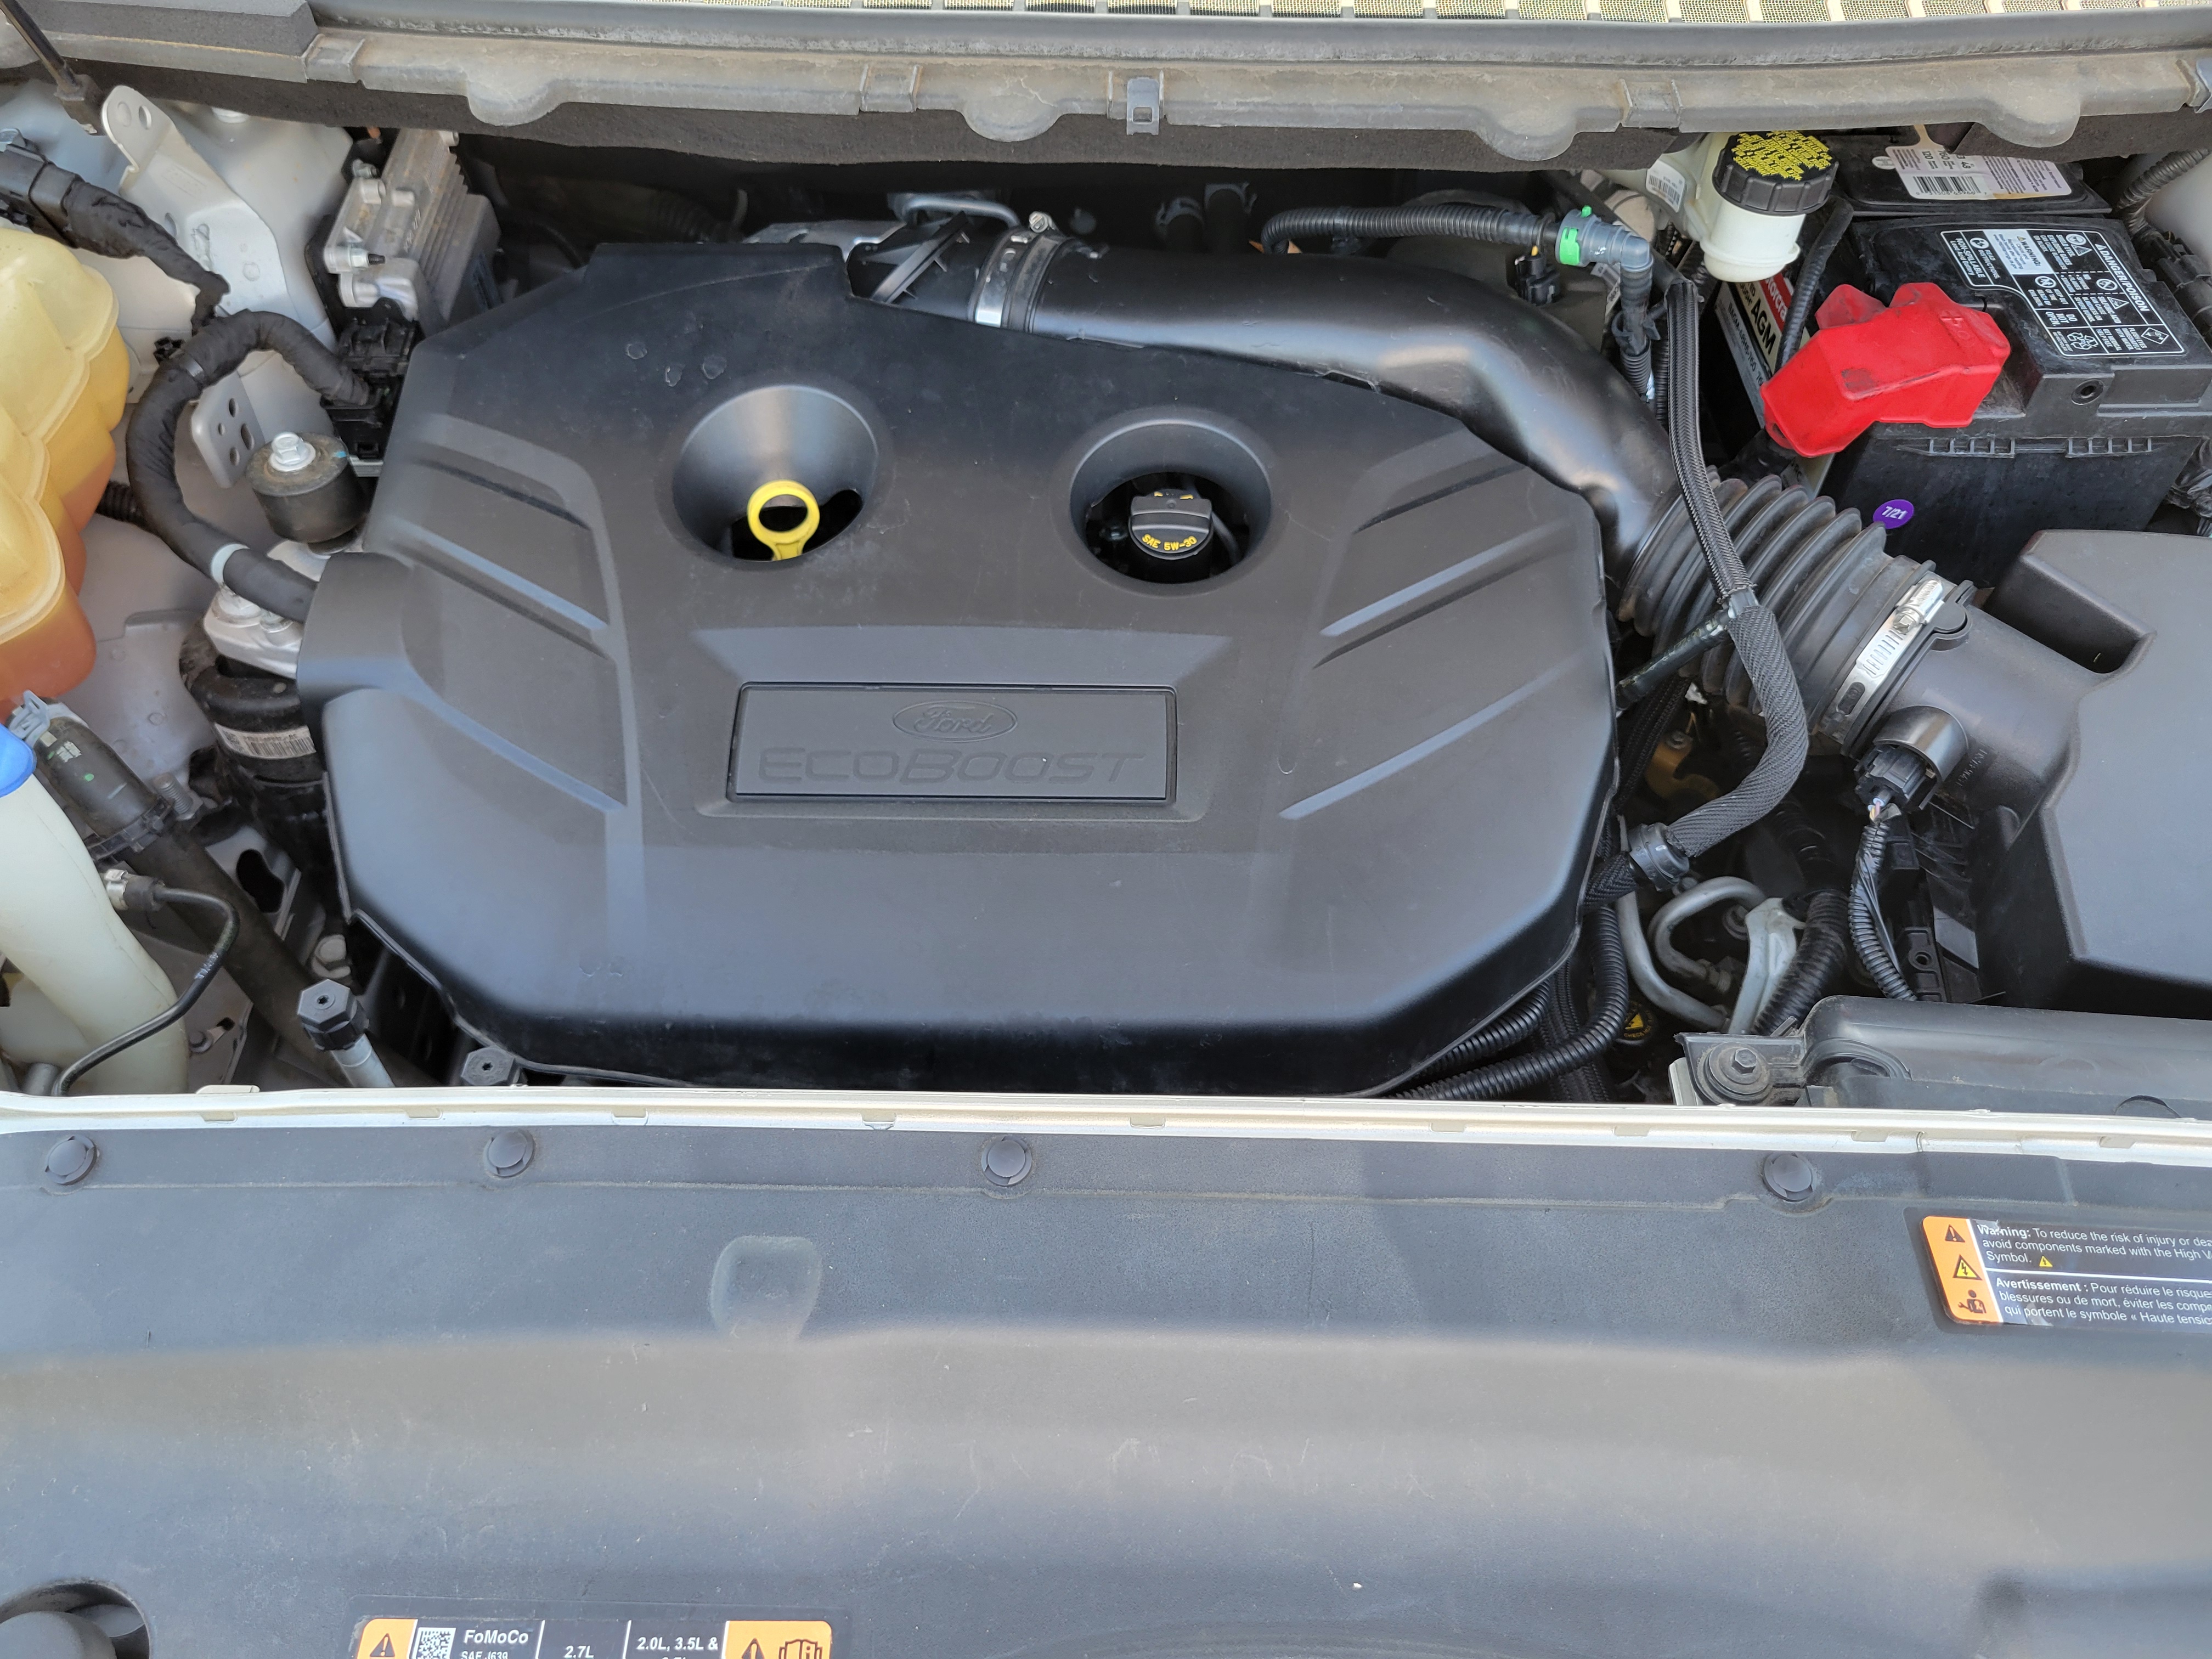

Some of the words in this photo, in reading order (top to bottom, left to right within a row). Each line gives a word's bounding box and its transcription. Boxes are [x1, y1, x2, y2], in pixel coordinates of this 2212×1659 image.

[1922, 151, 1933, 160] 120
[1949, 240, 1961, 250] Lead
[1954, 238, 1987, 278] NON-SPILLABLE
[1955, 251, 1967, 260] Acid
[1984, 250, 1996, 260] READ
[2019, 241, 2042, 266] WARNING:
[1960, 261, 1977, 275] Battery
[1976, 250, 2001, 279] INSTRUCTIONS.
[2097, 250, 2151, 311] DANGER/POISON
[2052, 289, 2064, 297] KEEP
[2094, 304, 2107, 314] CAUSE
[2096, 296, 2115, 313] SULFURIC
[2109, 314, 2122, 323] ACID
[2044, 311, 2062, 326] OPEN.
[2054, 313, 2069, 323] NOT
[1751, 297, 1776, 356] AGM
[2113, 328, 2125, 337] WITH
[2095, 329, 2107, 337] HELP
[2101, 338, 2113, 347] FAST.
[2107, 336, 2123, 351] MEDICAL
[2128, 328, 2141, 338] FLUSH
[2136, 339, 2147, 348] EYES
[1881, 505, 1907, 520] 7/21
[1142, 534, 1161, 549] SAE
[1164, 535, 1198, 551] 5W-30
[913, 706, 995, 735] Ford
[2032, 1228, 2047, 1237] To
[2050, 1229, 2087, 1240] reduce
[2090, 1231, 2108, 1241] the
[2111, 1232, 2131, 1243] risk
[2133, 1234, 2144, 1243] of
[2146, 1234, 2175, 1247] injury
[2179, 1237, 2190, 1245] or
[1982, 1239, 2012, 1249] avoid
[2015, 1240, 2083, 1253] components
[2085, 1244, 2126, 1255] marked
[2129, 1246, 2152, 1257] with
[2153, 1247, 2172, 1257] the
[2174, 1248, 2201, 1261] High
[1985, 1250, 2032, 1263] Symbol.
[1996, 1277, 2082, 1291] Avertissement
[2090, 1282, 2118, 1294] Pour
[2120, 1284, 2160, 1296] réduire
[2163, 1286, 2174, 1296] le
[1999, 1291, 2053, 1304] blessures
[2056, 1296, 2071, 1305] ou
[2074, 1295, 2088, 1306] de
[2091, 1297, 2121, 1308] mort,
[2123, 1297, 2154, 1309] éviter
[2156, 1299, 2174, 1310] les
[2005, 1305, 2022, 1316] qui
[2024, 1307, 2066, 1318] portent
[2066, 1308, 2077, 1319] le
[2079, 1310, 2128, 1321] symbole
[2140, 1312, 2175, 1323] Haute
[464, 1629, 529, 1644] FoMoCo
[636, 1637, 670, 1651] 2.0L,
[675, 1637, 704, 1650] 3.5L
[708, 1637, 718, 1650] &
[461, 1651, 483, 1659] SAE
[564, 1645, 594, 1658] 2.7L
